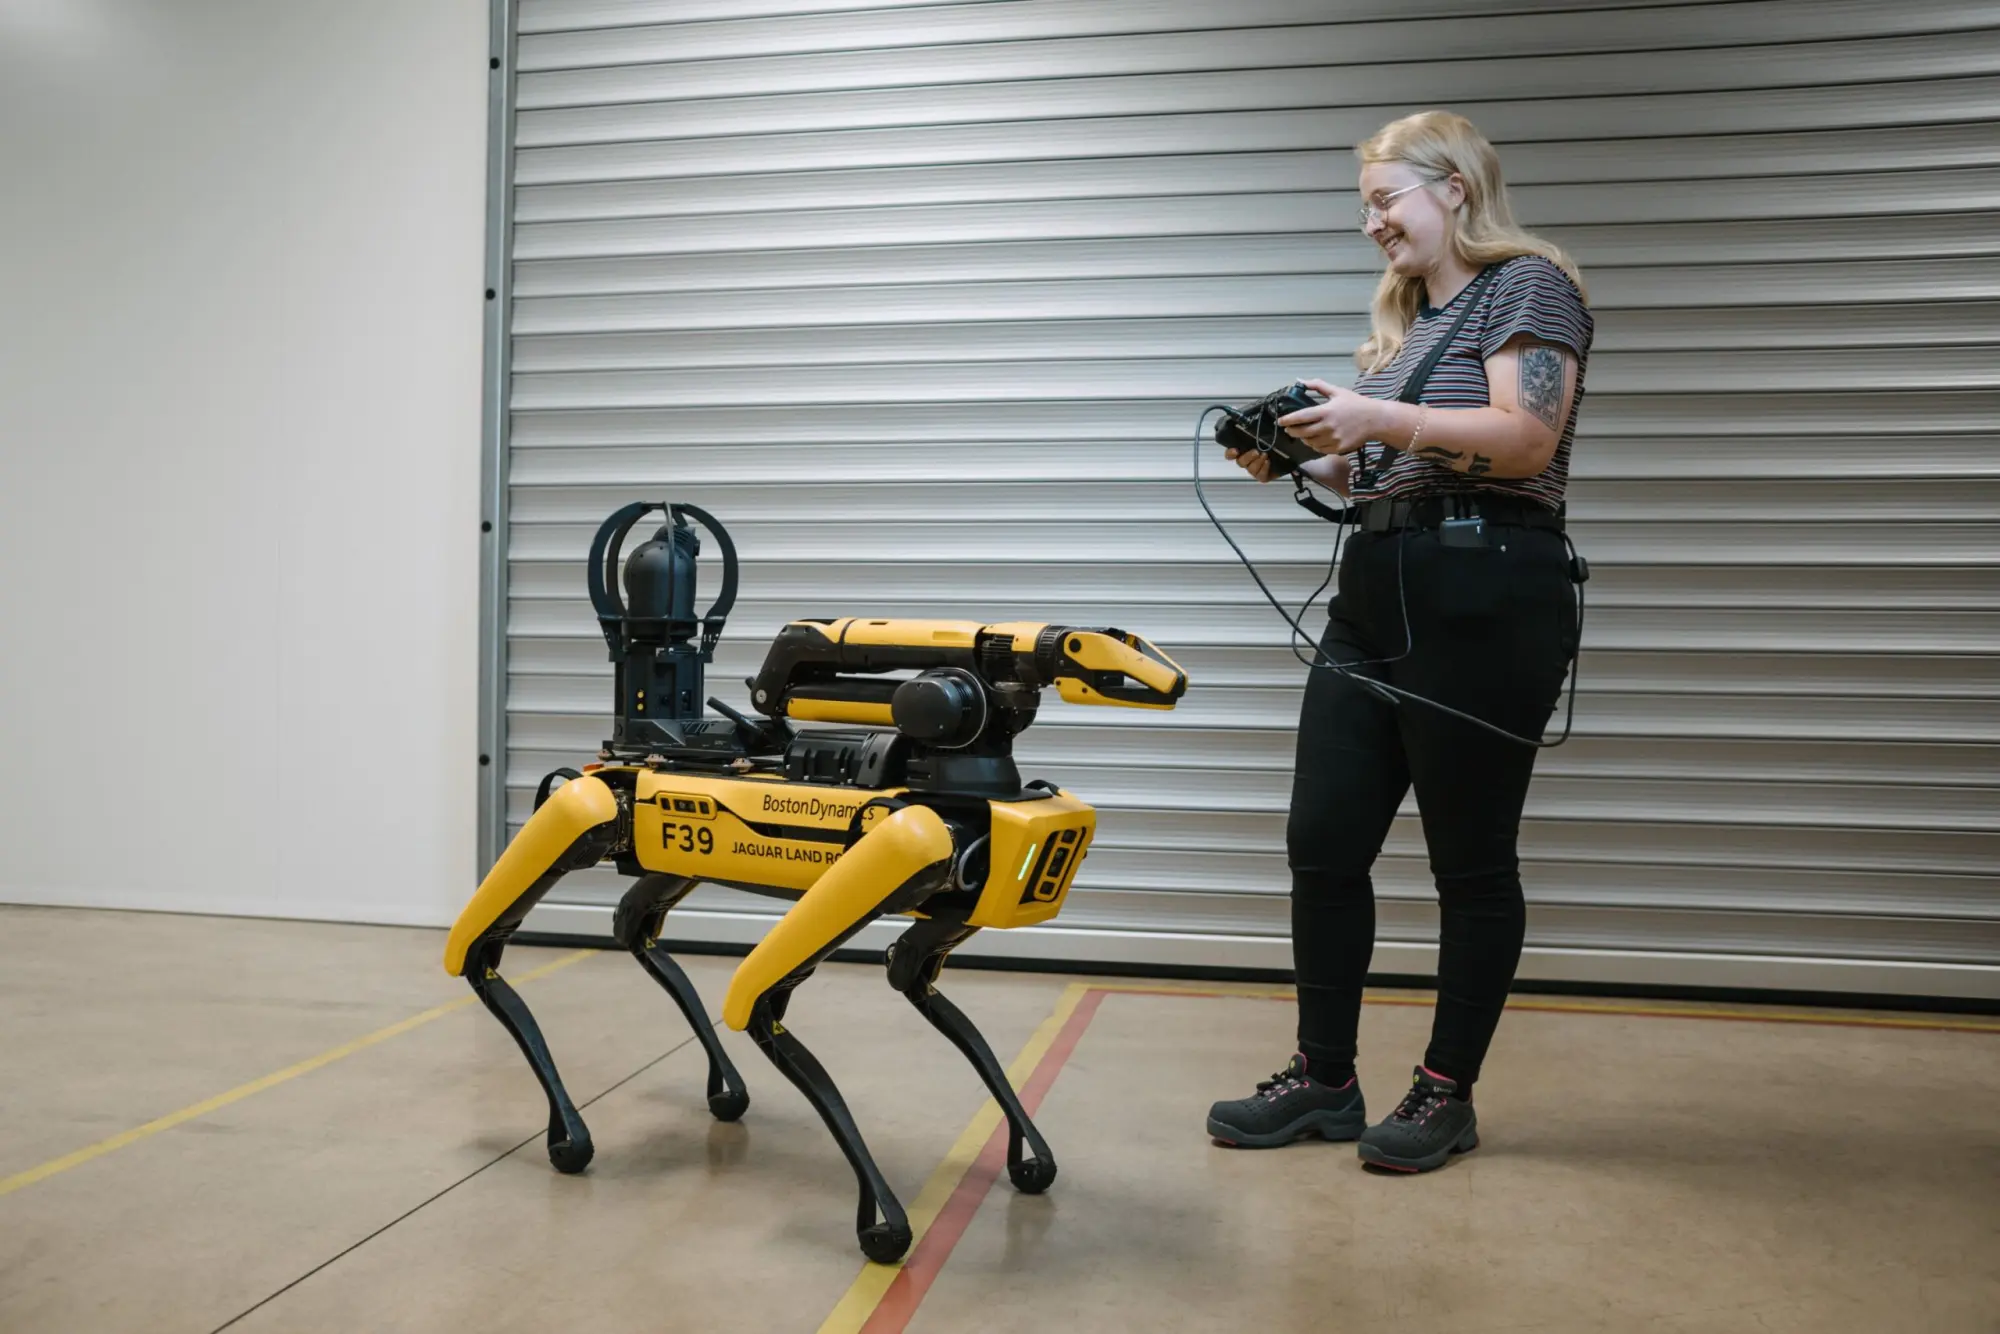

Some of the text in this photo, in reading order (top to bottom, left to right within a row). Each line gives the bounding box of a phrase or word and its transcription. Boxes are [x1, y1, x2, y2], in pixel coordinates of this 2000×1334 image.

[662, 823, 713, 855] F39
[732, 842, 783, 859] JAGUAR
[786, 848, 822, 863] LAND
